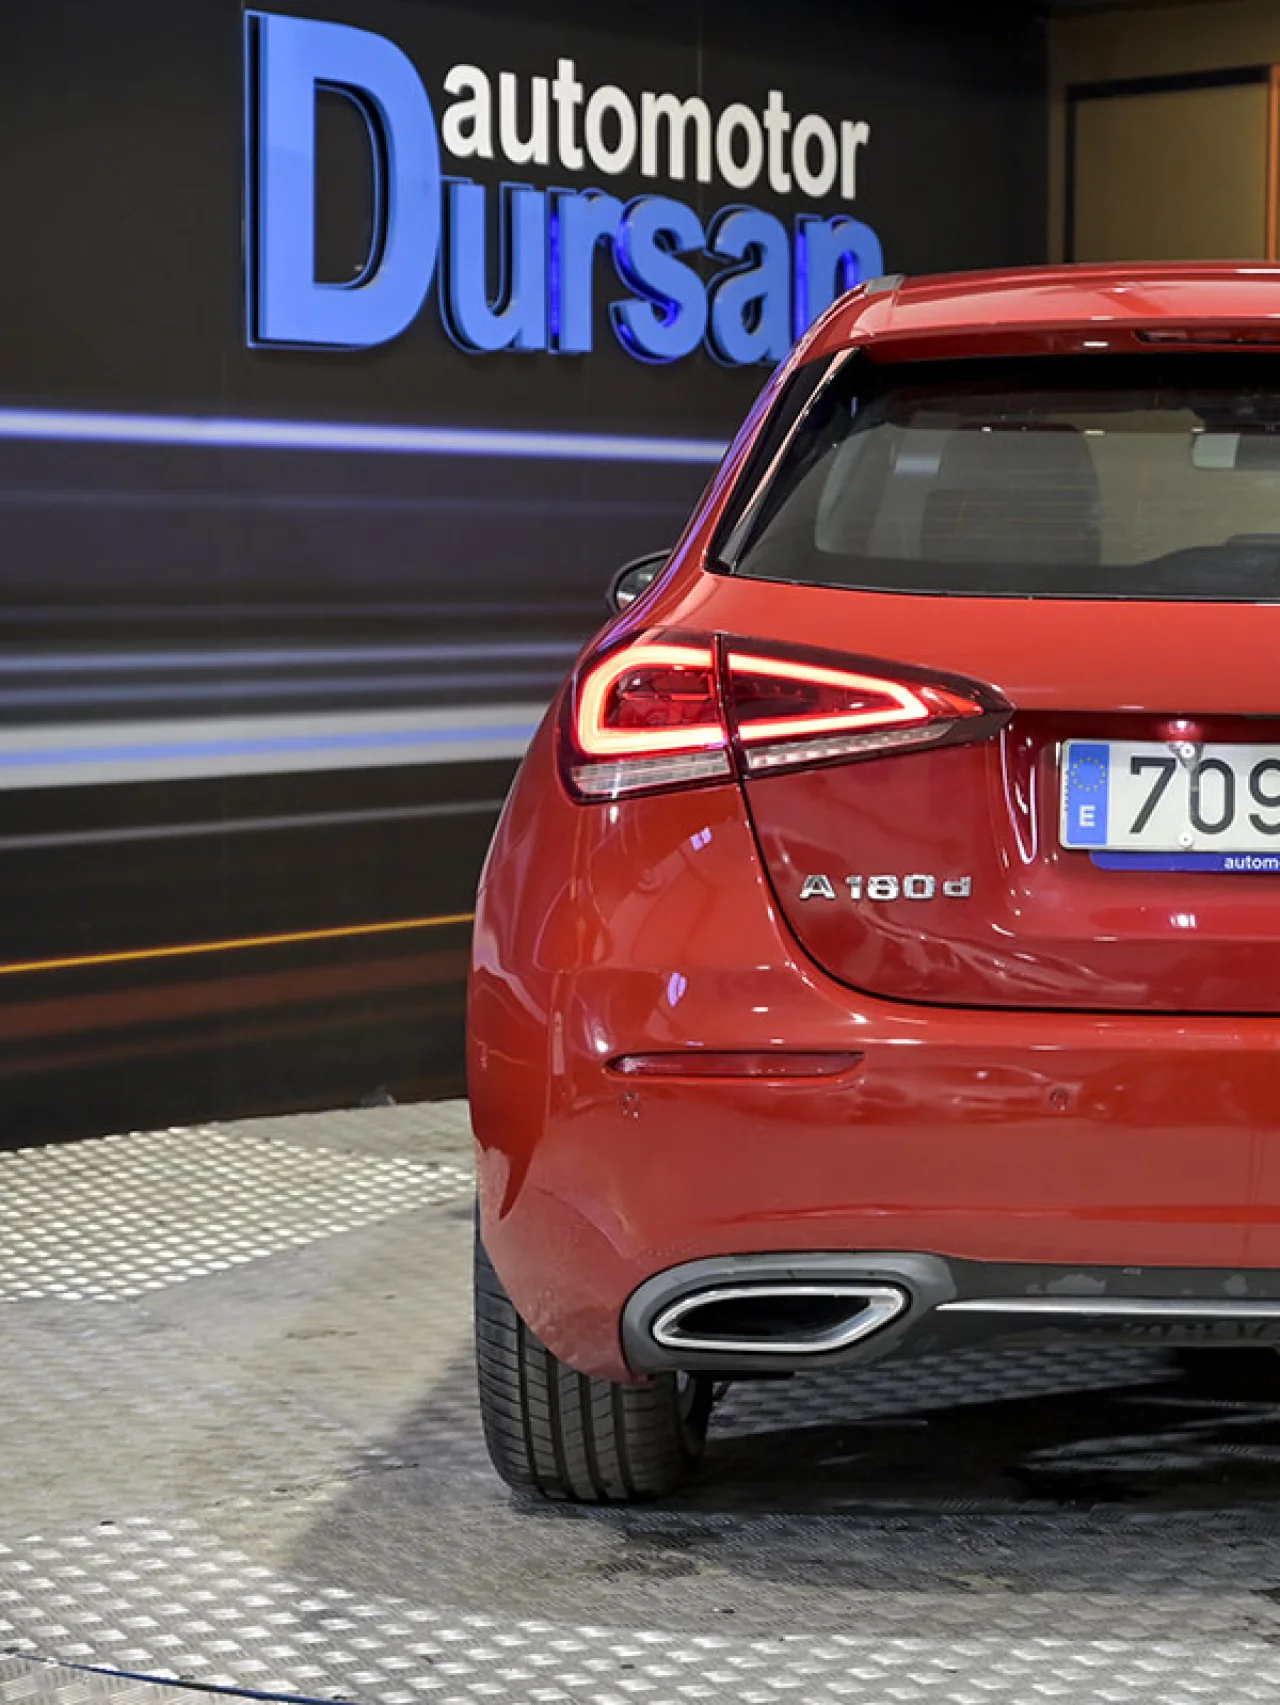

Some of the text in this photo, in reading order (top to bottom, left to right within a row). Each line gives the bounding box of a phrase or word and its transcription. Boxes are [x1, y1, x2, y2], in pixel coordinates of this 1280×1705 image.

[442, 58, 869, 199] automotor
[245, 9, 884, 366] Dursan
[1079, 805, 1096, 827] E
[799, 874, 836, 900] A
